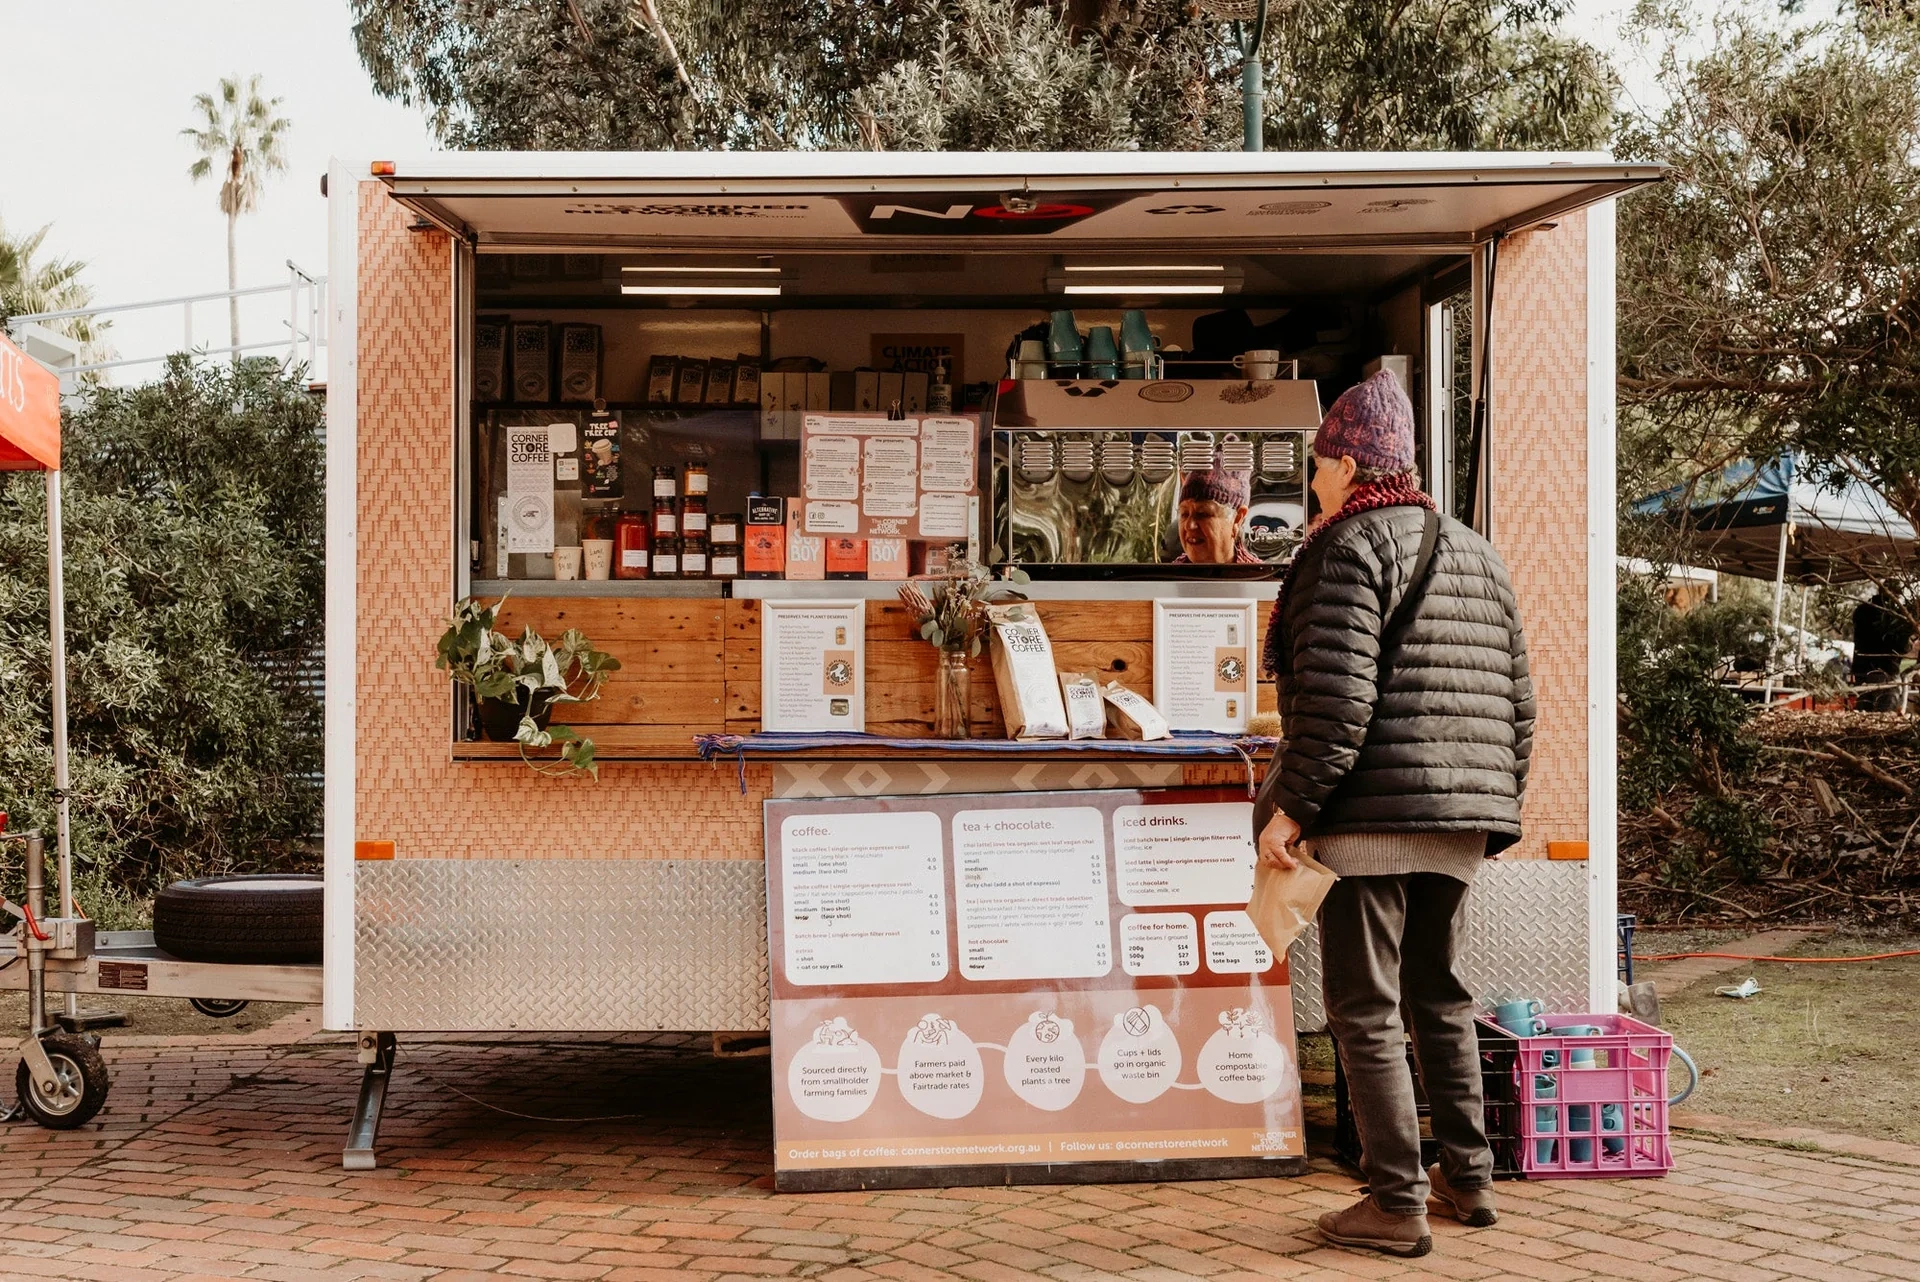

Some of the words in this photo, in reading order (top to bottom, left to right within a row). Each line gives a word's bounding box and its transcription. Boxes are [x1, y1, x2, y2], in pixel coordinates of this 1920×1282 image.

[882, 346, 951, 358] CLIMATE
[511, 434, 548, 442] CORNER
[511, 443, 549, 452] STORE
[511, 453, 549, 462] COFFEE
[790, 544, 820, 562] BOY
[871, 544, 901, 562] BOY
[1008, 635, 1043, 644] STORE
[1012, 644, 1046, 652] COFFEE
[963, 823, 980, 831] tea
[994, 820, 1054, 830] chocolate.
[1122, 817, 1146, 826] iced
[1149, 816, 1188, 826] drinks.
[792, 827, 831, 836] coffee.
[1117, 1049, 1138, 1058] Cups
[1148, 1048, 1162, 1056] lids
[1026, 1055, 1047, 1064] Every
[1049, 1054, 1064, 1062] kilo
[948, 1060, 966, 1068] paid
[1136, 1060, 1166, 1069] organic
[1215, 1062, 1268, 1072] compostable
[837, 1065, 867, 1075] directly
[823, 1077, 869, 1085] smallholder
[1022, 1078, 1046, 1086] plants
[1246, 1074, 1265, 1083] bags
[913, 1082, 948, 1090] Fairtrade
[804, 1089, 834, 1098] farming
[836, 1088, 867, 1096] families
[1060, 1141, 1096, 1151] Follow
[1099, 1142, 1113, 1150] us:
[1116, 1137, 1228, 1150] @cornerstorenetwork
[789, 1149, 819, 1159] Order
[822, 1148, 848, 1160] bags
[850, 1147, 860, 1157] of
[863, 1146, 899, 1157] coffee:
[901, 1144, 1041, 1156] cornerstorenetwork.org.au
